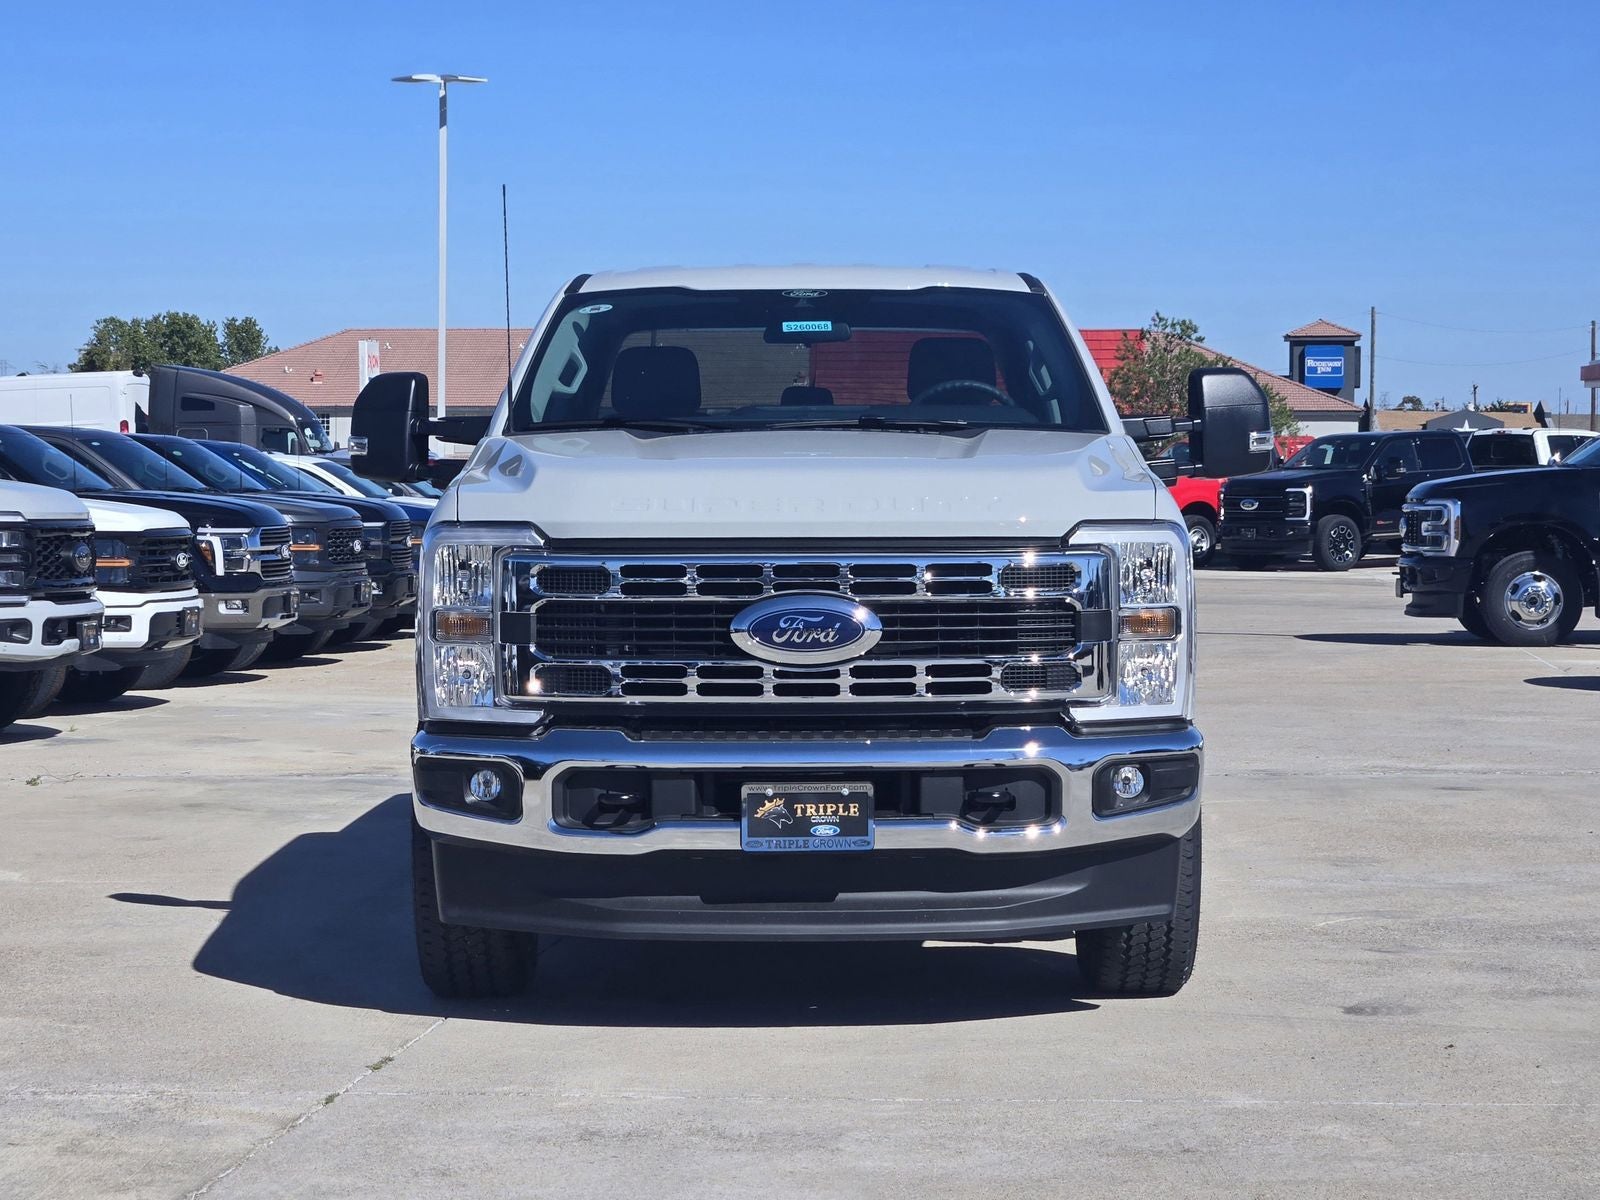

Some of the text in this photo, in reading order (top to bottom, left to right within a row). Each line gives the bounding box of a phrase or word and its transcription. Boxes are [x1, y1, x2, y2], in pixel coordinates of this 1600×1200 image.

[771, 615, 841, 644] Ford
[748, 784, 869, 792] wwwTripleCrownFordcom
[793, 803, 859, 817] TRIPLE
[766, 839, 810, 849] TRIPLE
[812, 838, 852, 849] CROWN
